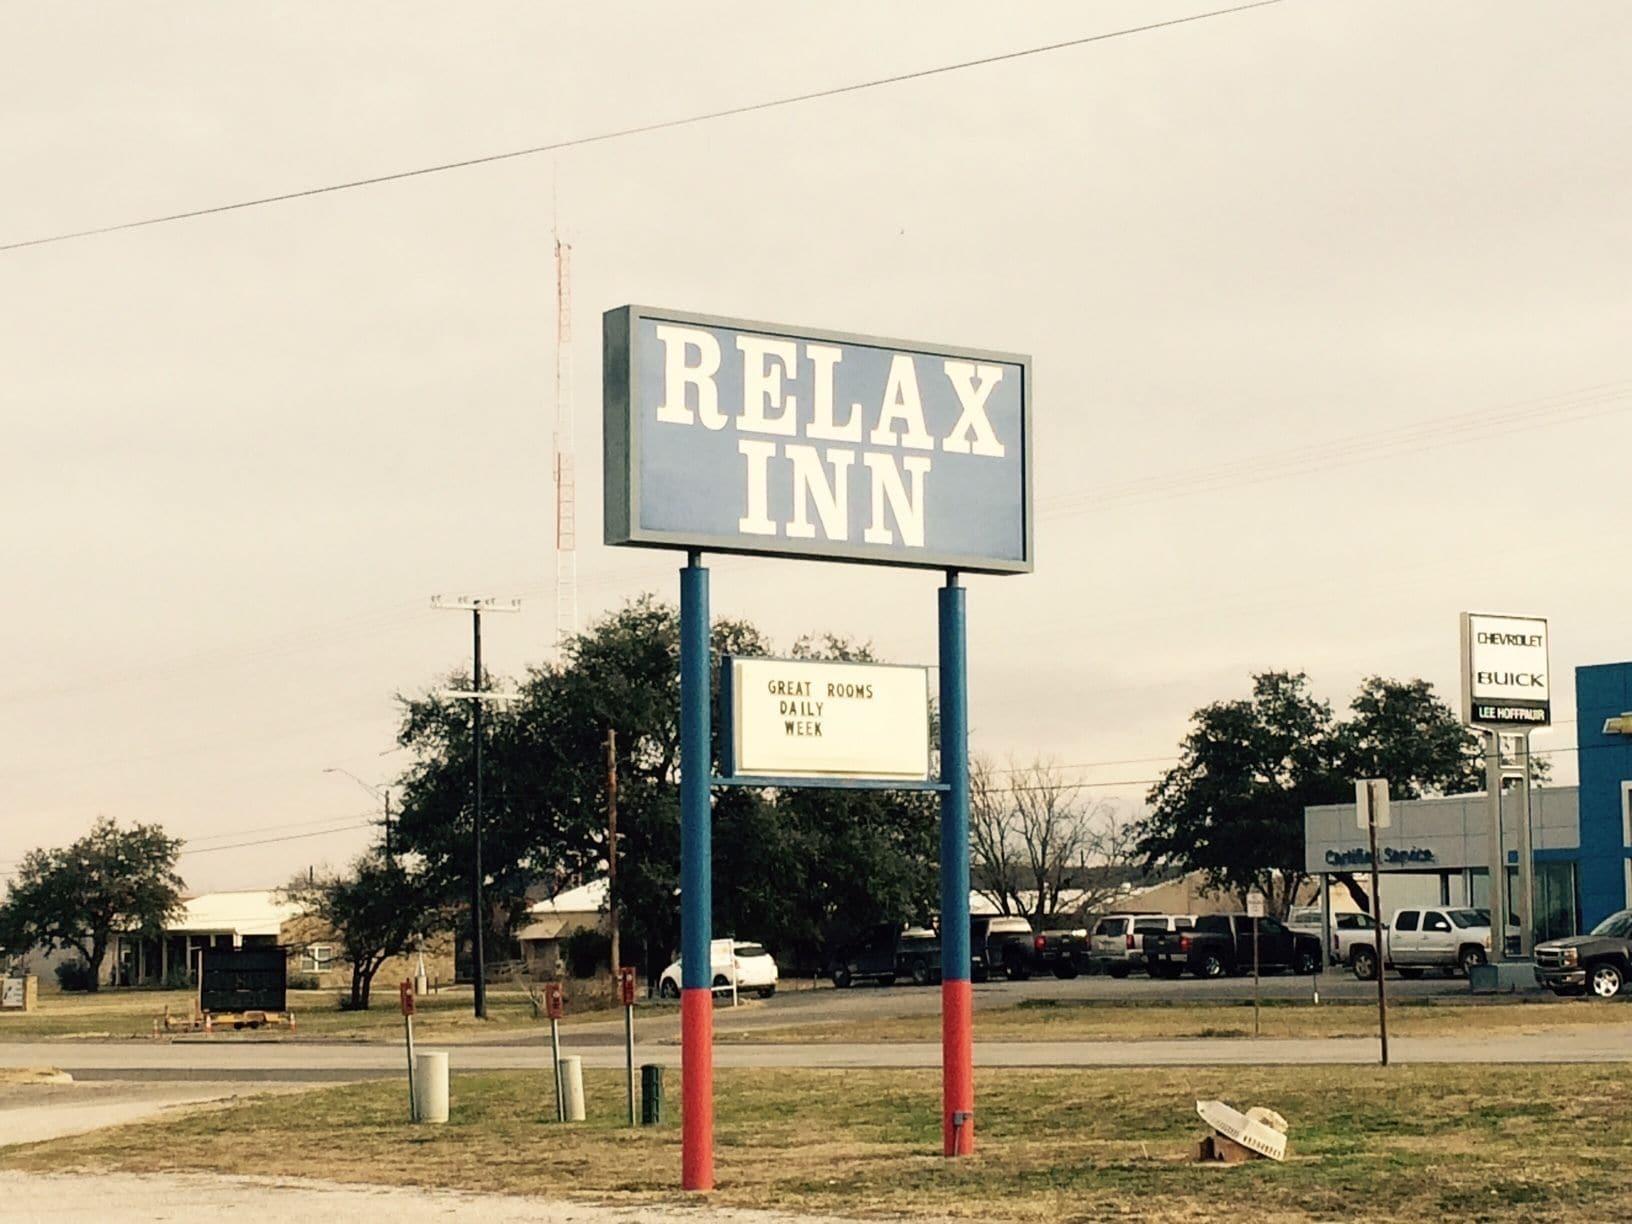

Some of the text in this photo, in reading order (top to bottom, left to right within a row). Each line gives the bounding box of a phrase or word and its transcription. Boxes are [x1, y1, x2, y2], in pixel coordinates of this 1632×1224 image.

[655, 325, 1006, 458] RELAX
[737, 438, 933, 548] INN
[1477, 632, 1543, 648] CHEVROLET
[1477, 671, 1545, 688] BUICK
[768, 680, 874, 699] GREAT ROOMS
[779, 700, 825, 717] DAILY
[1478, 706, 1496, 720] LEE
[784, 720, 823, 737] WEEK
